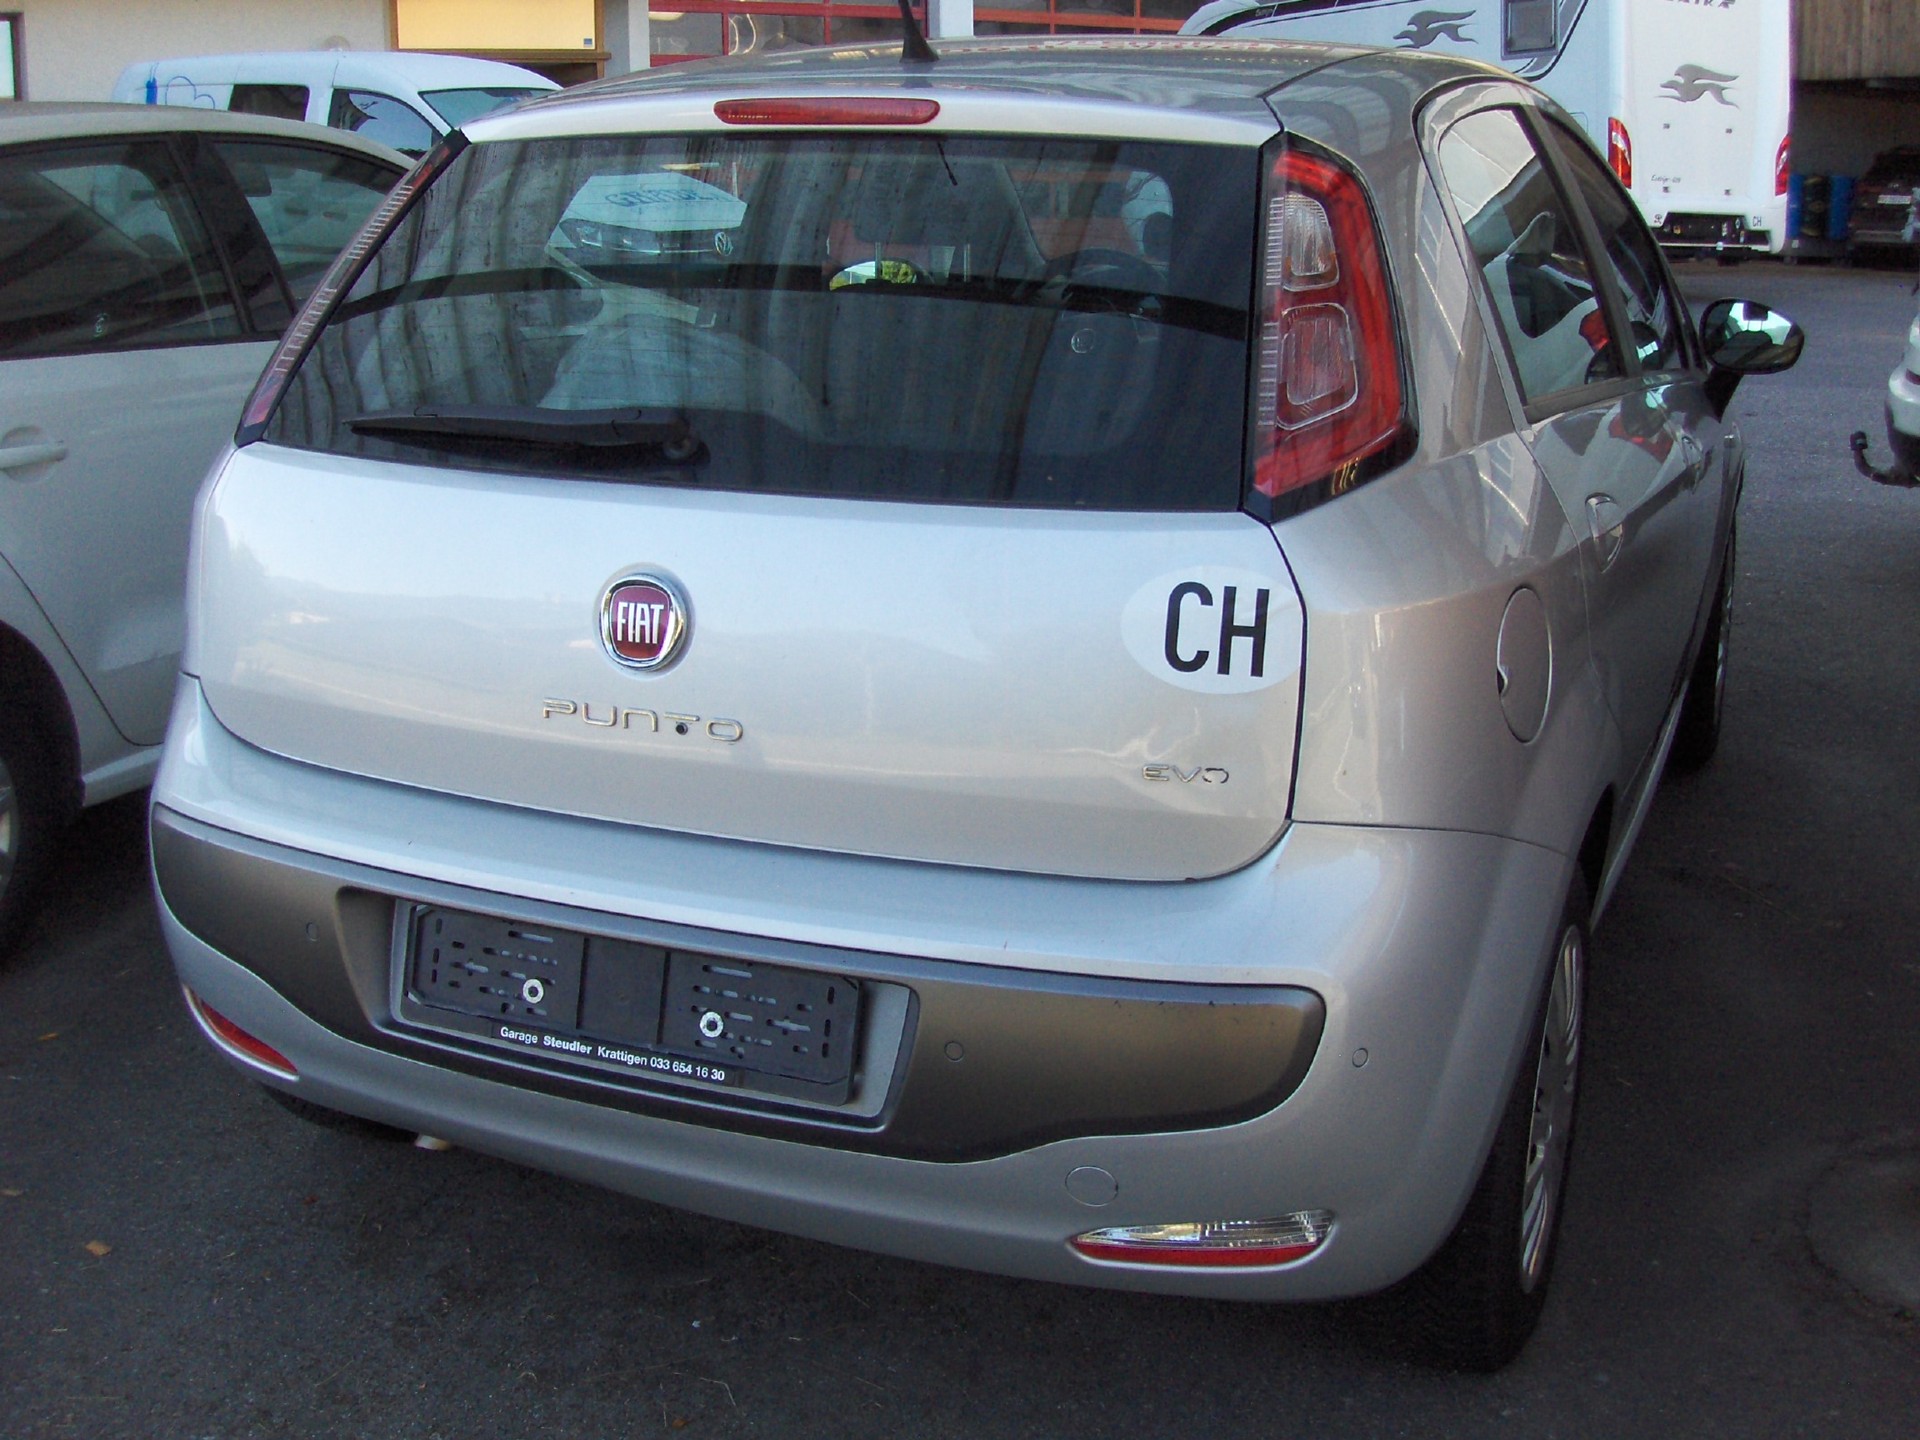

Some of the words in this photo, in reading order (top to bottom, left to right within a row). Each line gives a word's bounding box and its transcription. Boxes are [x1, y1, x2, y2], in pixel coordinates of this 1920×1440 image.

[1752, 215, 1762, 227] CH
[616, 601, 664, 644] FIAT
[1165, 581, 1270, 678] CH
[543, 697, 743, 742] PUNTO
[1143, 763, 1230, 784] EVO
[500, 1026, 538, 1045] Garage
[543, 1035, 593, 1055] Steudler
[597, 1046, 648, 1066] Krattigen
[650, 1056, 671, 1070] 033
[672, 1060, 692, 1075] 654
[695, 1065, 709, 1078] 16
[711, 1068, 725, 1081] 30
